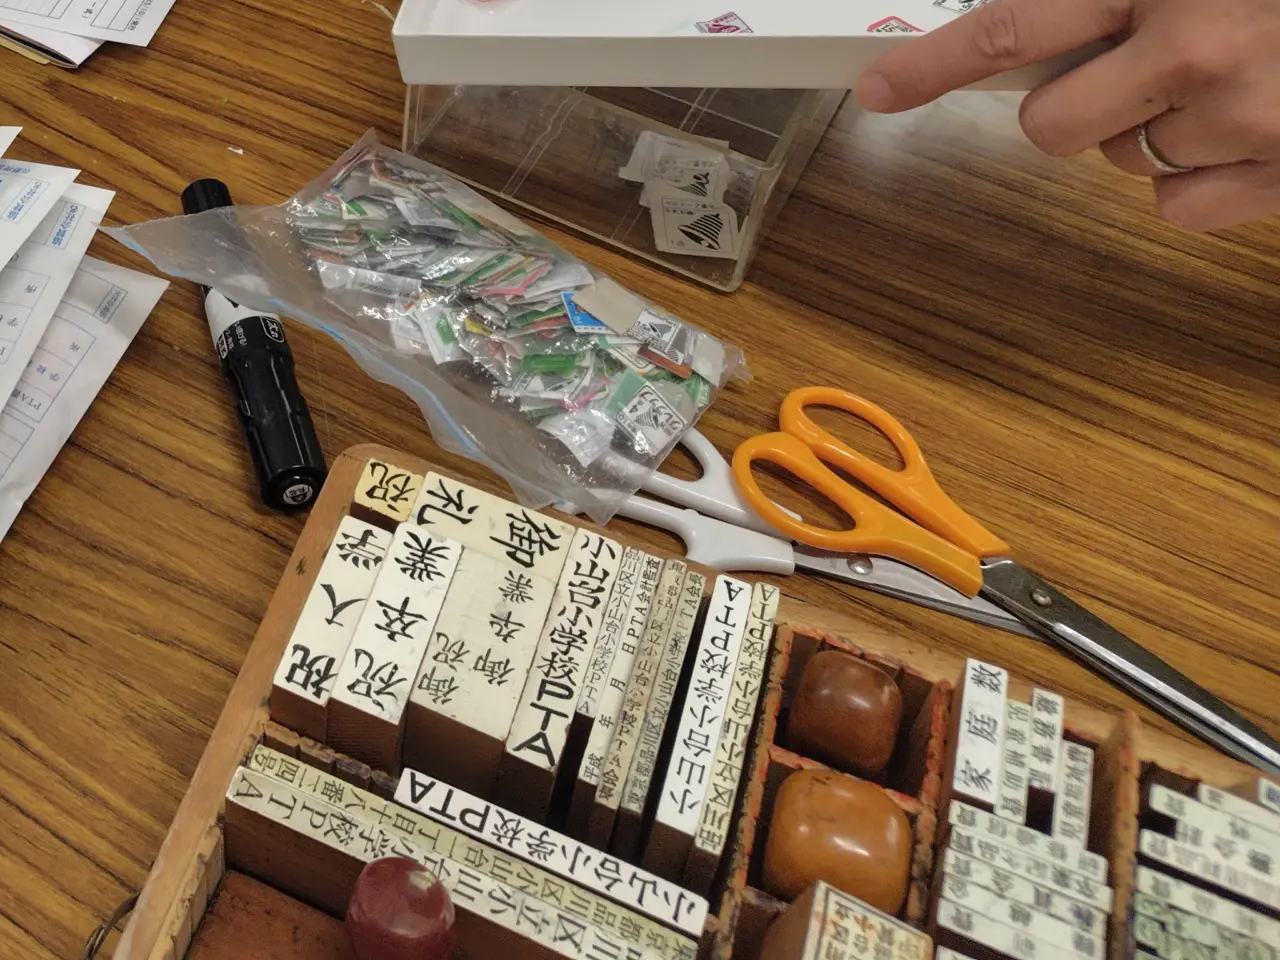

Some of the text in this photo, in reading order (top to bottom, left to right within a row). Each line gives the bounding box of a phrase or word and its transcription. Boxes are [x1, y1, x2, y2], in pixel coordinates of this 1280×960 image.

[364, 461, 419, 514] 祝
[418, 478, 561, 568] 御礼
[283, 528, 390, 698] 祝入学
[348, 529, 453, 710] 祝卒業
[417, 632, 472, 708] 御祝
[512, 533, 619, 766] 小山台小学校PTA
[578, 547, 643, 715] 品川区立小山台小学校PTA
[666, 580, 744, 817] 小山台小学校PTA
[695, 583, 778, 852] 品川区立小山台小学校PTA
[958, 664, 1005, 792] 家庭数
[398, 769, 697, 926] 小山台小学校PTA
